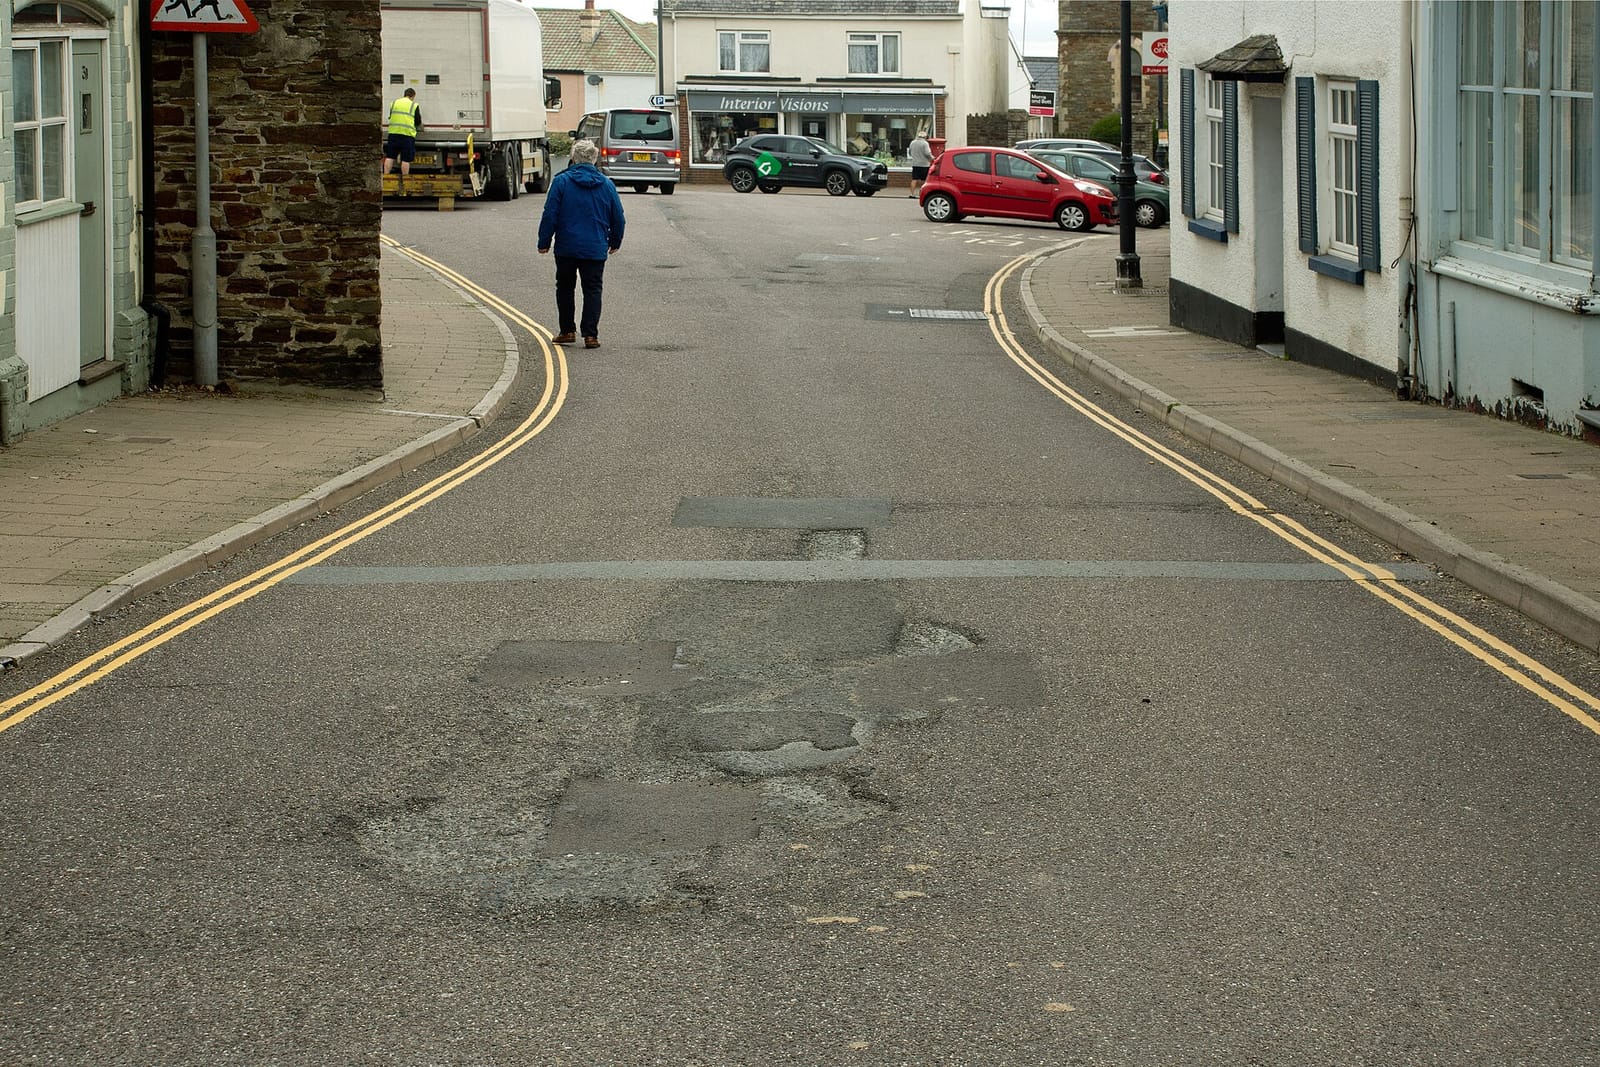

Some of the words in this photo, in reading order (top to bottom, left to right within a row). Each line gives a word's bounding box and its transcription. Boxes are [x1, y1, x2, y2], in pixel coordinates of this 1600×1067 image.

[81, 65, 89, 80] 3
[720, 96, 776, 110] Interior
[780, 97, 829, 111] Visions
